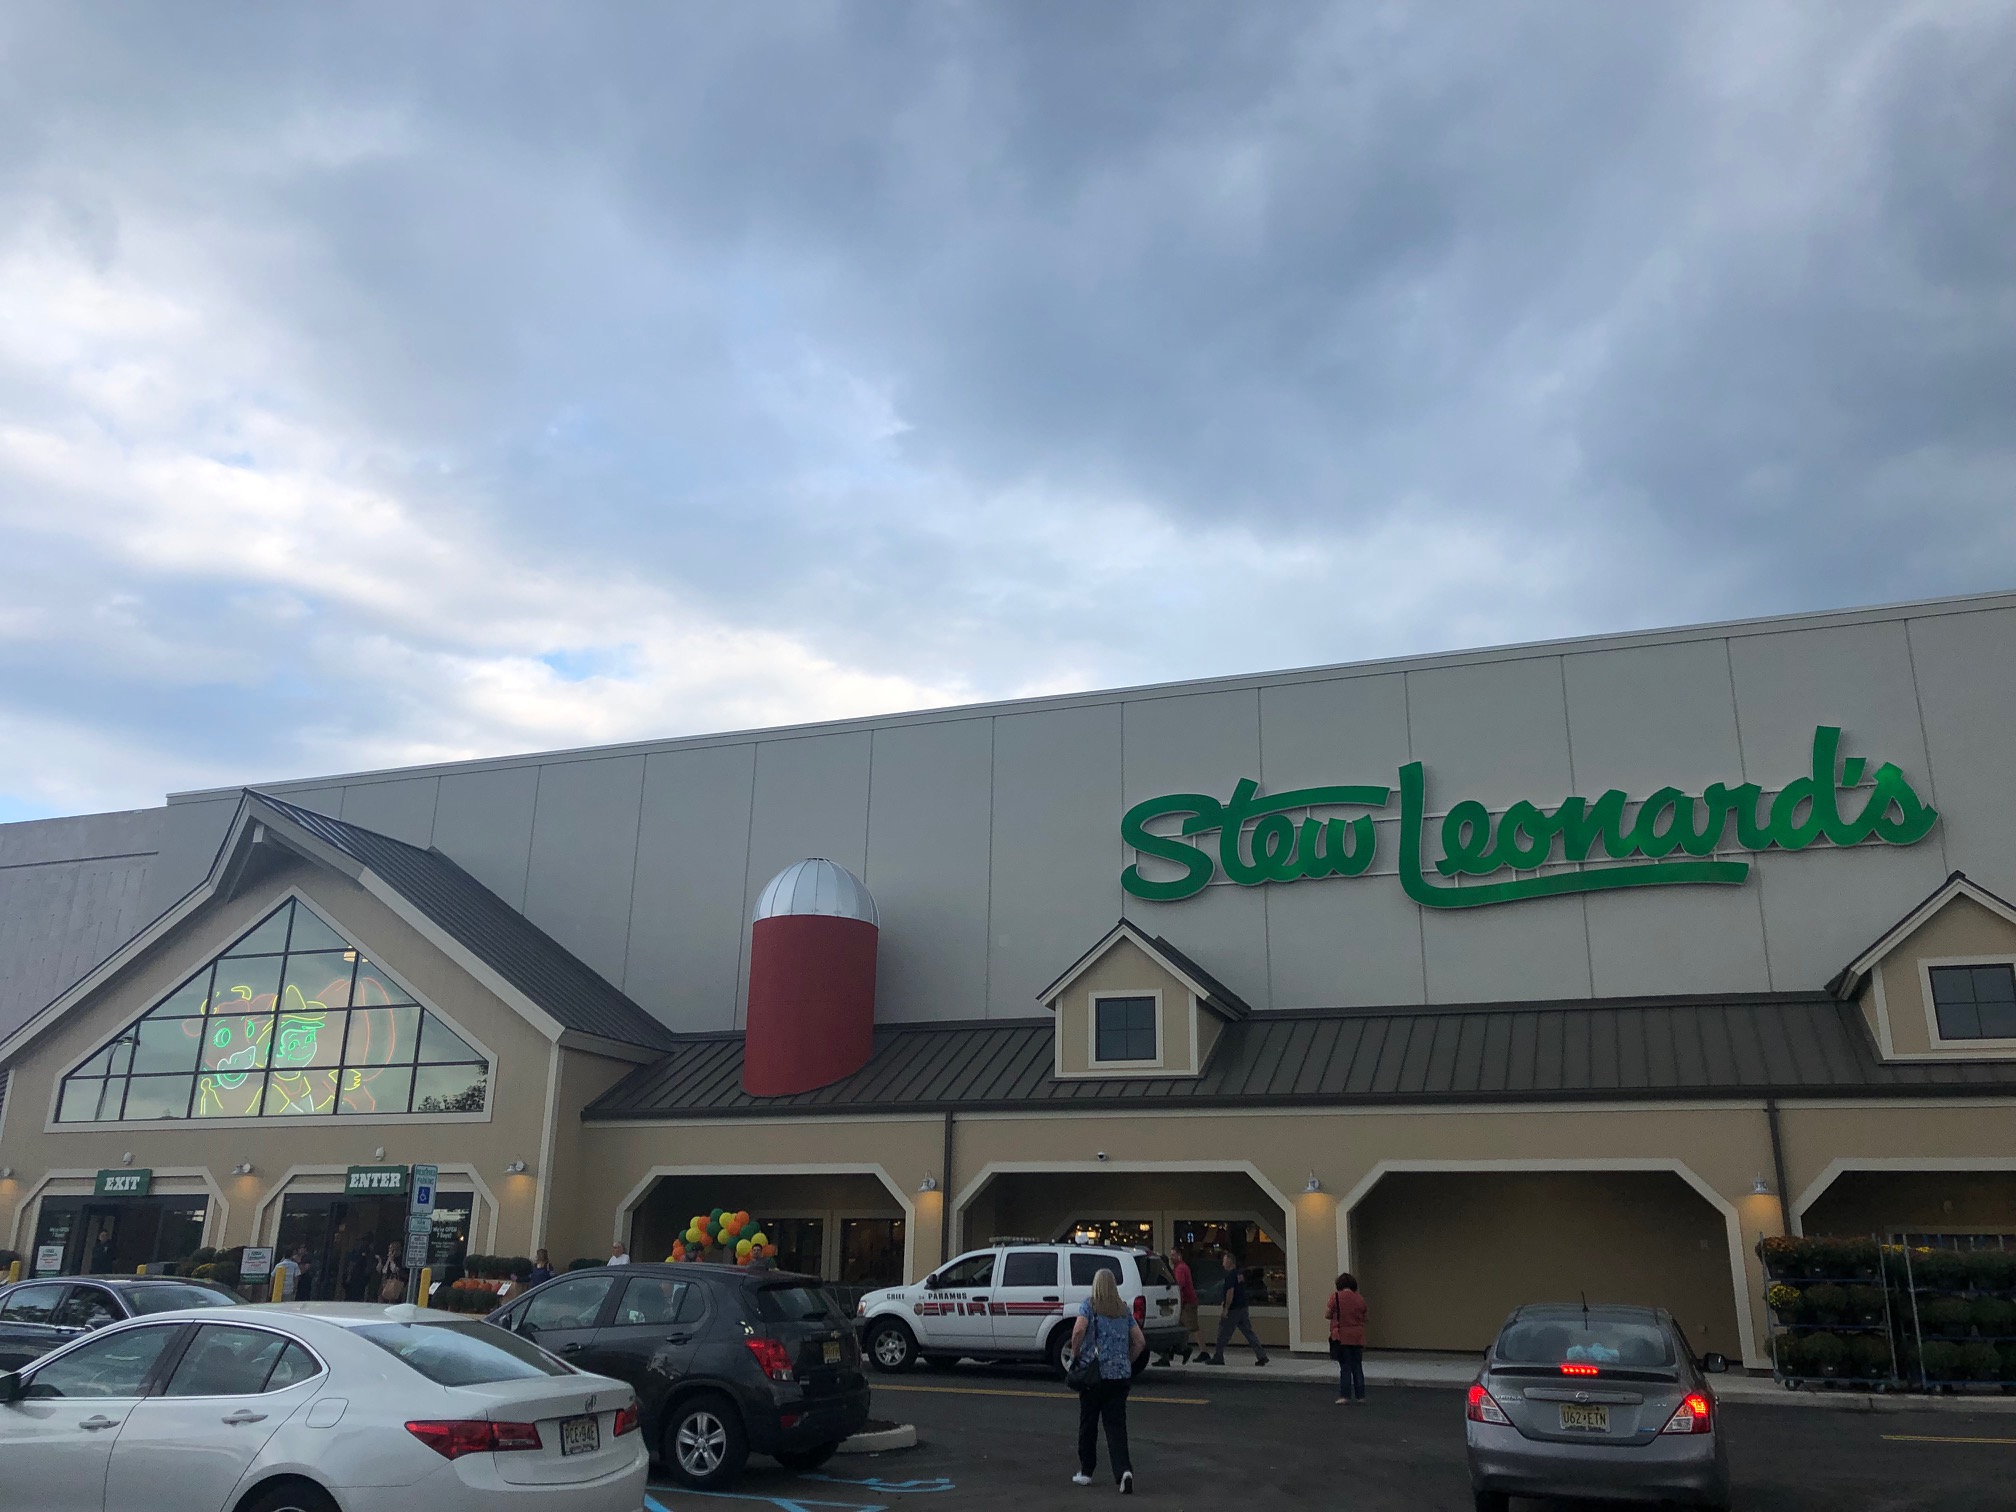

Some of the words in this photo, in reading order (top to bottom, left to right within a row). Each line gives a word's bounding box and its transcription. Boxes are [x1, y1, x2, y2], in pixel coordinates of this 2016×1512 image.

[1121, 777, 1391, 902] Stew
[1398, 726, 1940, 908] Leonard's
[104, 1176, 141, 1191] EXIT
[350, 1172, 401, 1188] ENTER
[928, 1292, 968, 1300] PARAMUS
[939, 1302, 1007, 1317] FIRE
